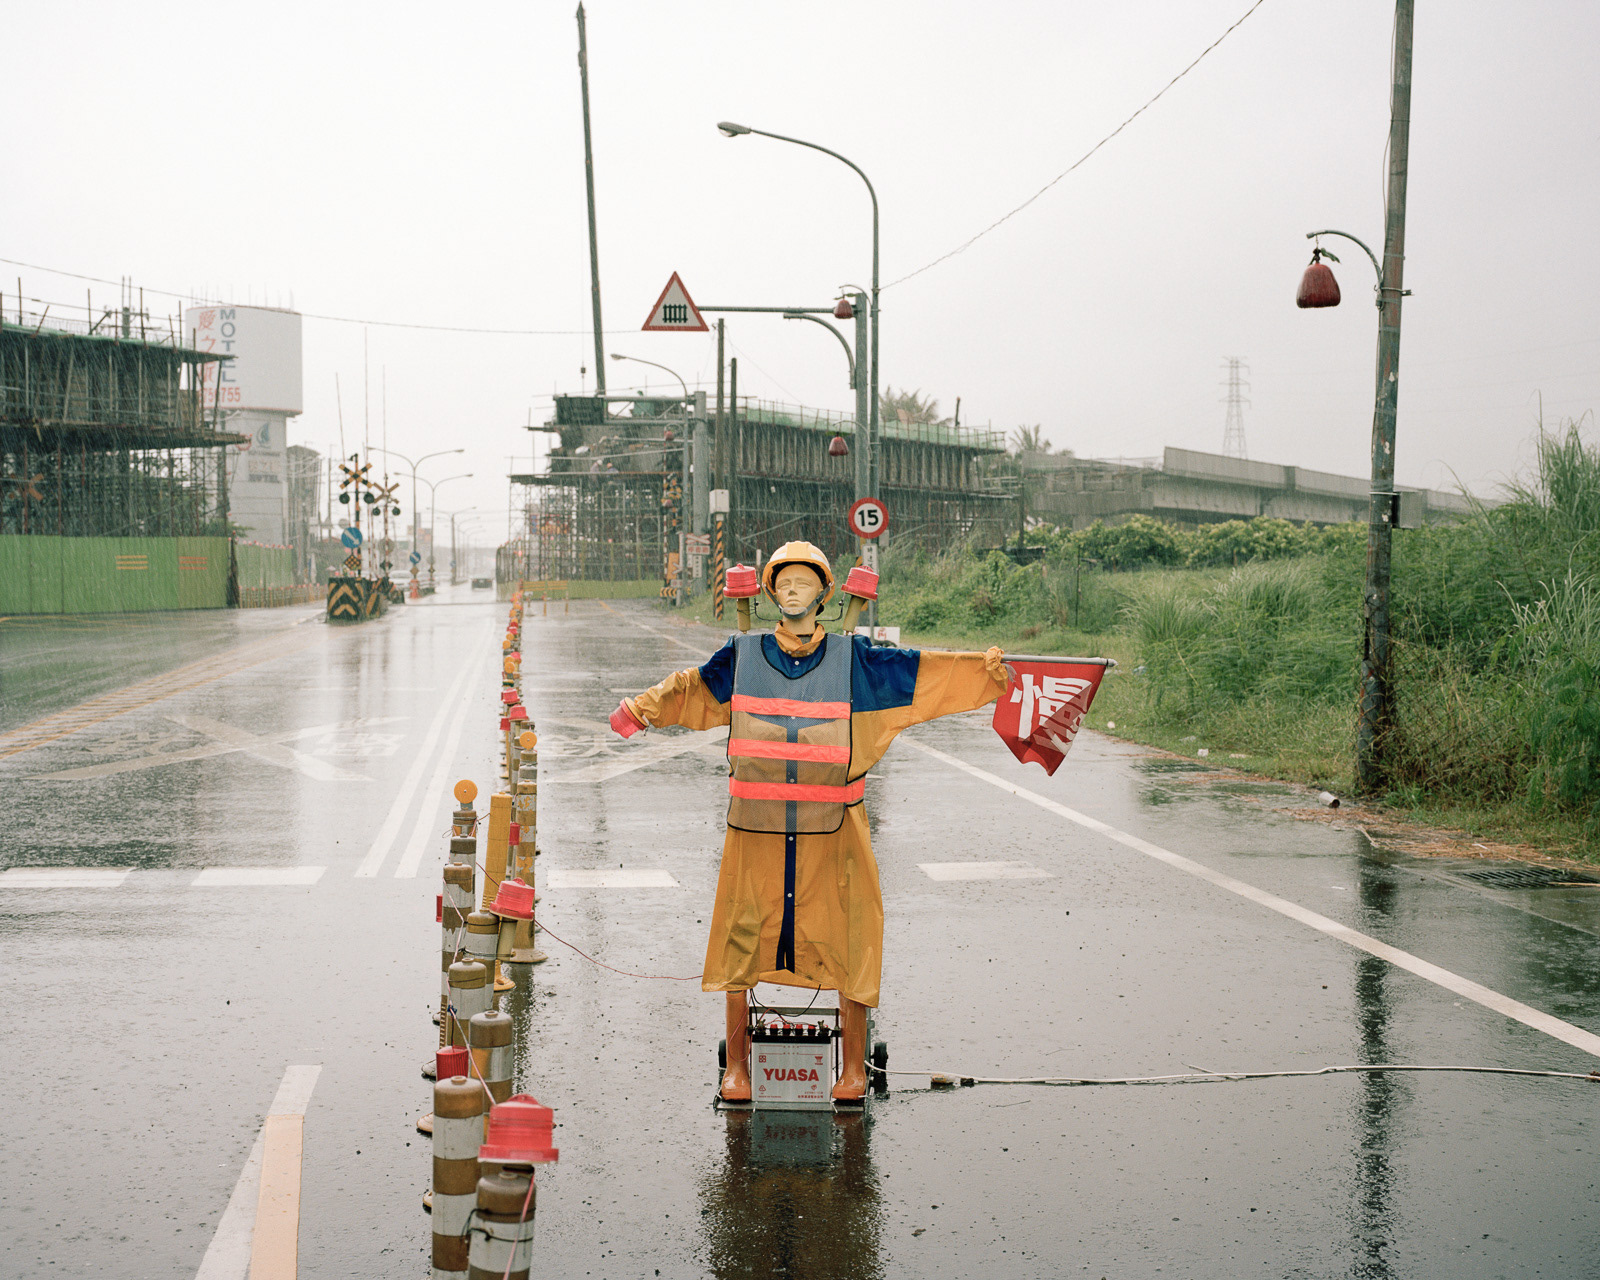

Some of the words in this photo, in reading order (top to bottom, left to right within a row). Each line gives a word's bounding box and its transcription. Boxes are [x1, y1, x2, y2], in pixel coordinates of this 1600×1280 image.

[220, 308, 237, 382] MOTEL
[858, 509, 879, 527] 15
[1010, 673, 1092, 755] 慢
[763, 1068, 819, 1081] YUASA
